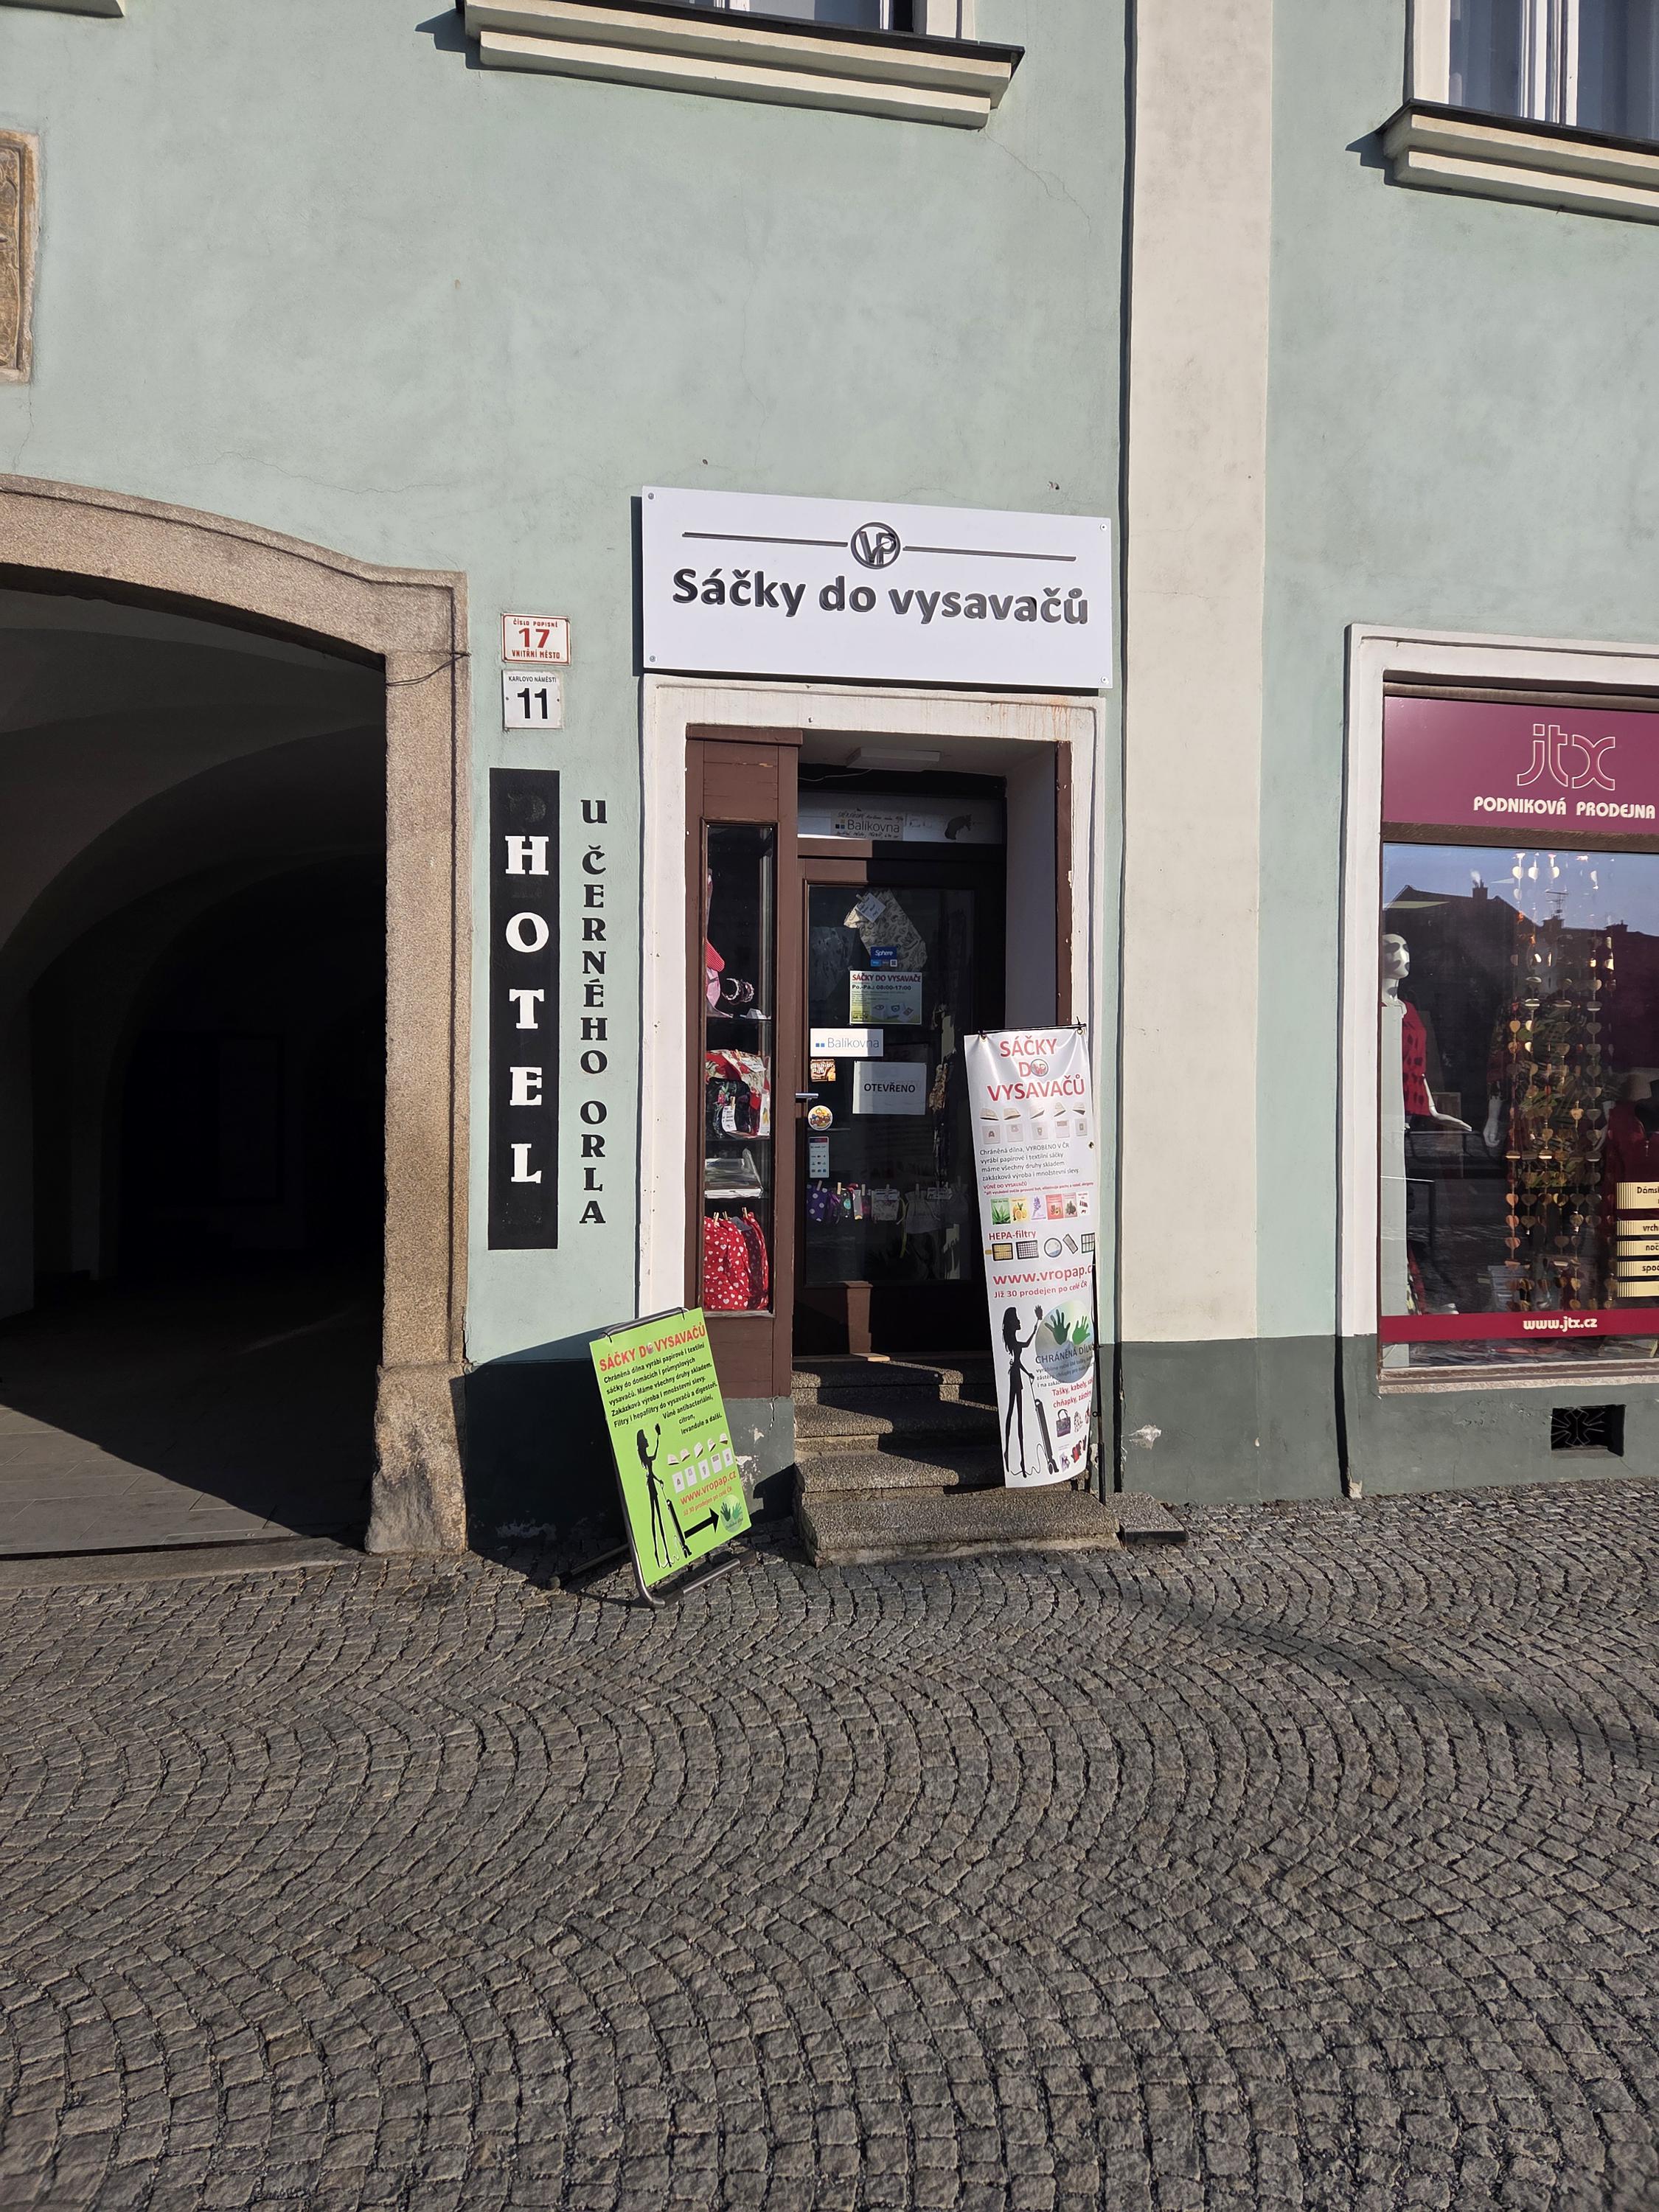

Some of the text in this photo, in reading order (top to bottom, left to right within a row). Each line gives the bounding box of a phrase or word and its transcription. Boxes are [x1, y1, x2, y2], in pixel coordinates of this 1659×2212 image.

[672, 567, 1089, 625] Sáčky do vysavačů
[519, 628, 550, 648] 17
[512, 649, 560, 659] VNITŘNÍ MĚSTO
[517, 688, 548, 719] 11
[1517, 723, 1615, 790] jtx
[1473, 796, 1656, 820] PODNIKOVÁ PRODEJNA
[580, 844, 608, 1075] ČERNÉHO
[852, 973, 874, 981] SÁČKY
[888, 974, 920, 982] VYSAVAČE
[505, 834, 549, 1184] HOTEL
[827, 1037, 880, 1048] Balíkovna
[1000, 1035, 1057, 1057] SÁČKY
[864, 1082, 916, 1093] OTEVŘENO
[987, 1074, 1085, 1102] VYSAVAČŮ
[580, 1101, 608, 1224] ORLA
[989, 1230, 1036, 1240] HEPA-filtry
[1643, 1223, 1659, 1231] vrch
[992, 1265, 1091, 1284] www.vropap.c
[1020, 1285, 1057, 1298] prodejen
[1059, 1284, 1068, 1293] po
[1523, 1315, 1597, 1332] www.jtx.cz
[599, 1348, 636, 1371] SÁČKY
[654, 1321, 706, 1352] VYSAVAČŮ
[1035, 1346, 1077, 1364] CHRÁNĚNÁ
[604, 1370, 630, 1383] Chráněná
[631, 1365, 644, 1373] dílna
[663, 1351, 684, 1364] papírové
[607, 1385, 623, 1394] sáčky
[632, 1371, 658, 1385] domácích
[662, 1357, 695, 1374] průmyslových
[609, 1363, 712, 1406] vysavačů. Máme všechny druhy skladem.
[1052, 1386, 1070, 1397] Tašky,
[611, 1401, 641, 1416] Zakázková
[641, 1394, 659, 1405] výroba
[664, 1380, 692, 1396] množstevní
[692, 1375, 706, 1385] slevy.
[1053, 1397, 1078, 1408] chňapky,
[613, 1417, 629, 1428] Filtry
[633, 1405, 658, 1419] hepafiltry
[667, 1392, 690, 1407] vysavačů
[662, 1409, 676, 1419] Vůně
[678, 1413, 695, 1425] citron,
[681, 1419, 704, 1435] levandule
[680, 1471, 737, 1505] www.vropap.cz
